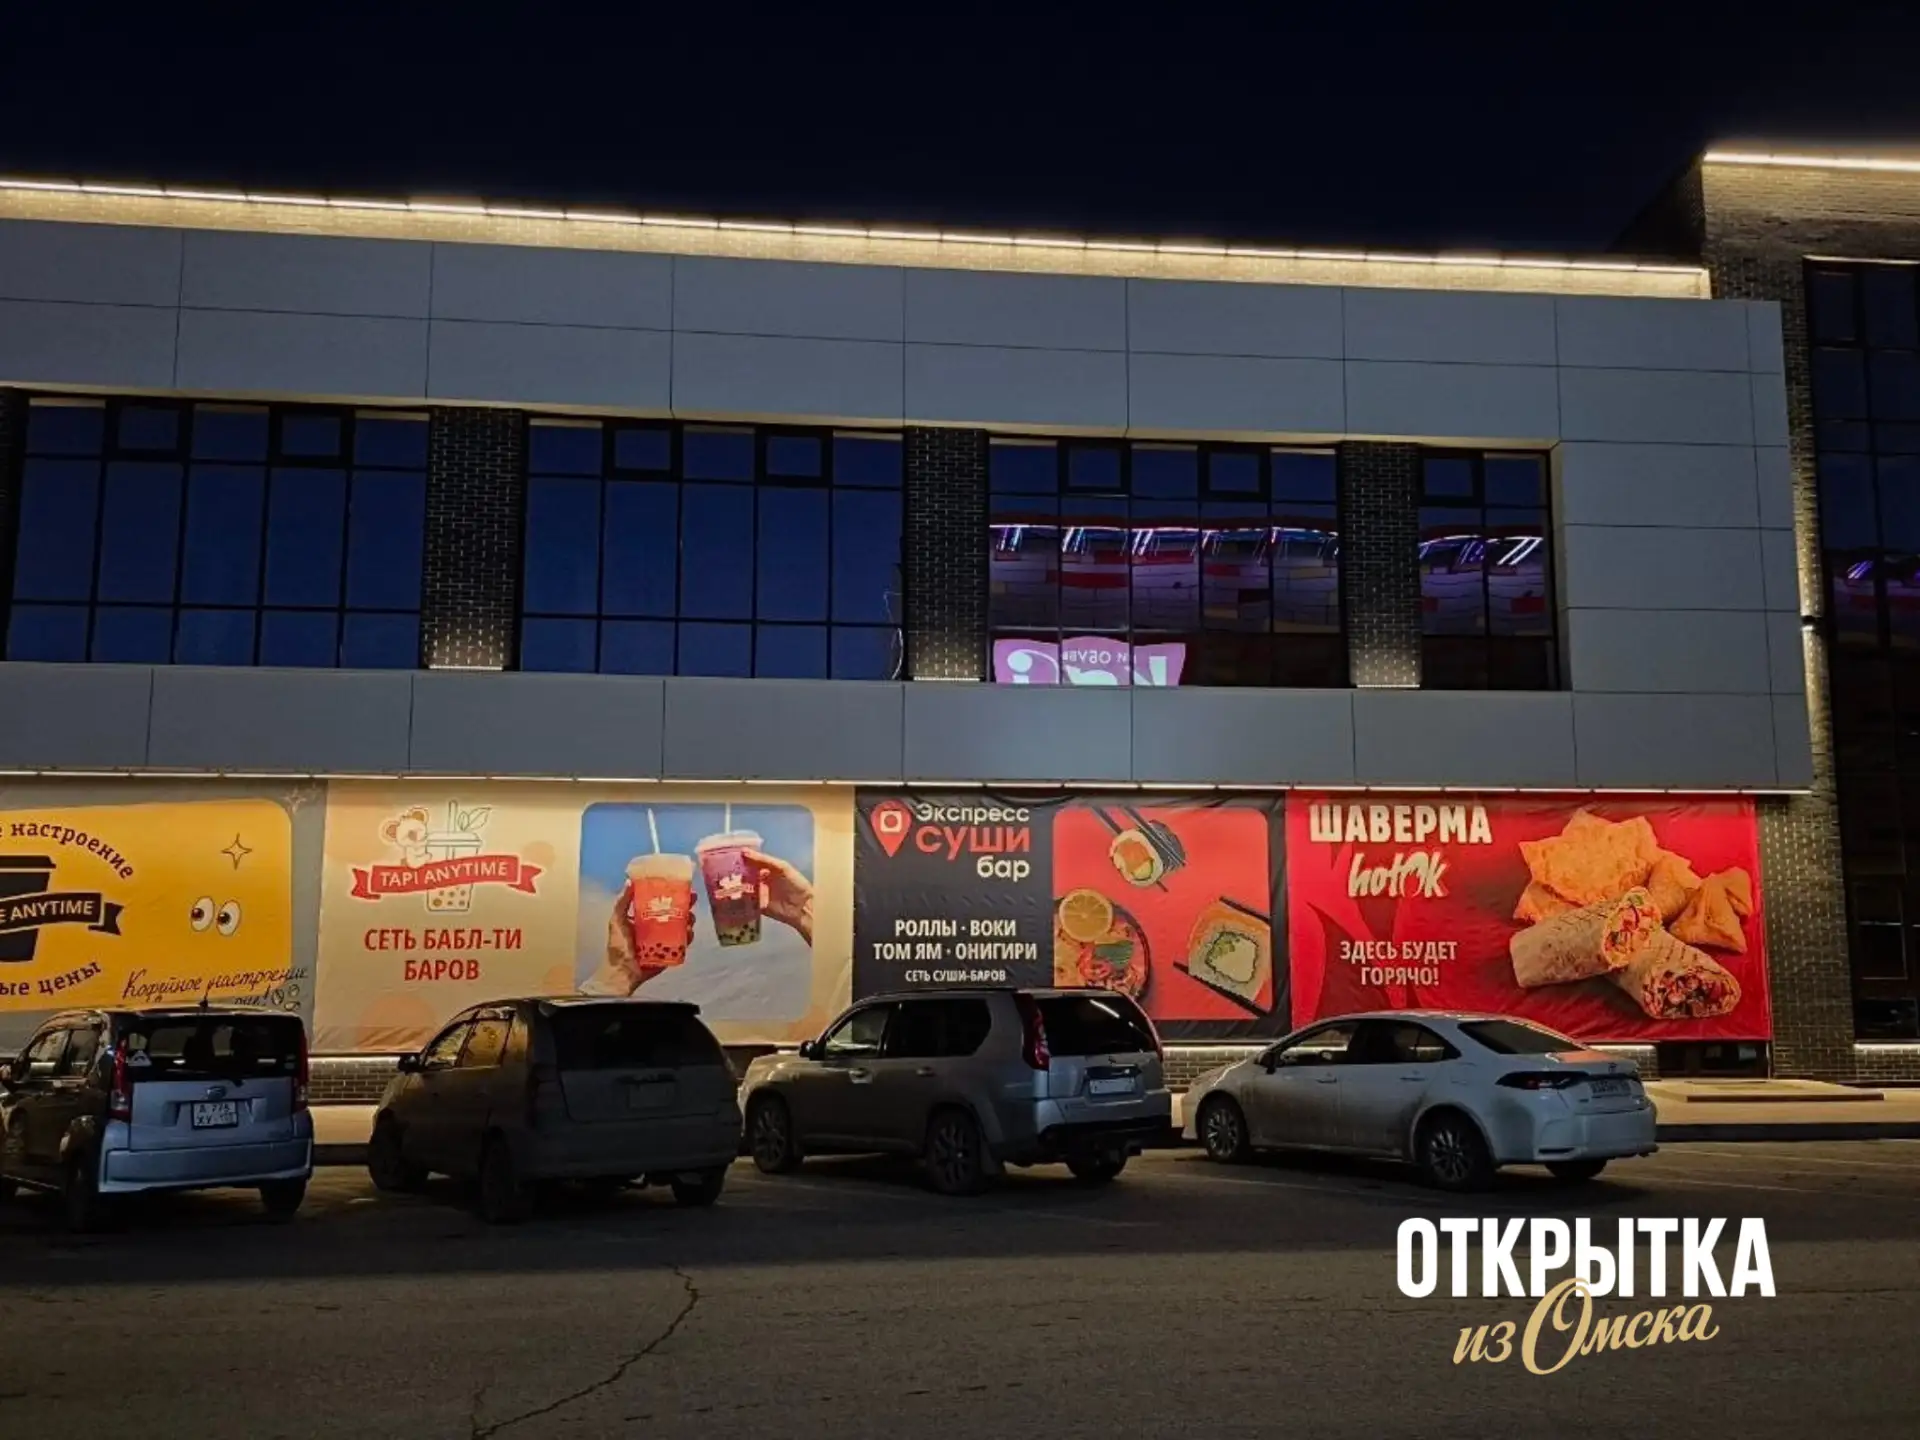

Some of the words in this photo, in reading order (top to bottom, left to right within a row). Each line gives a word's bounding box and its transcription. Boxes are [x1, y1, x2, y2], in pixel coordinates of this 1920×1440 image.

[916, 803, 1030, 825] Экспресс
[1309, 804, 1493, 844] ШАВЕРМА
[11, 822, 134, 880] настроение
[916, 826, 1030, 861] суши
[381, 870, 419, 887] TAPI
[424, 861, 508, 884] ANYTIME
[977, 855, 1030, 882] бар
[10, 900, 94, 921] ANYTIME
[895, 919, 956, 937] РОЛЛЫ
[970, 919, 1016, 936] ВОКИ
[364, 929, 416, 950] СЕТЬ
[424, 929, 522, 949] БАБЛ-ТИ
[873, 943, 910, 960] ТОМ
[915, 943, 942, 960] ЯМ
[955, 943, 1037, 960] ОНИГИРИ
[1340, 941, 1397, 964] ЗДЕСЬ
[1402, 941, 1458, 963] БУДЕТ
[38, 960, 101, 994] цены
[404, 959, 479, 981] БАРОВ
[905, 970, 930, 982] СЕТЬ
[933, 970, 1006, 982] СУШИ-БАРОВ
[1361, 967, 1439, 985] ГОРЯЧО!
